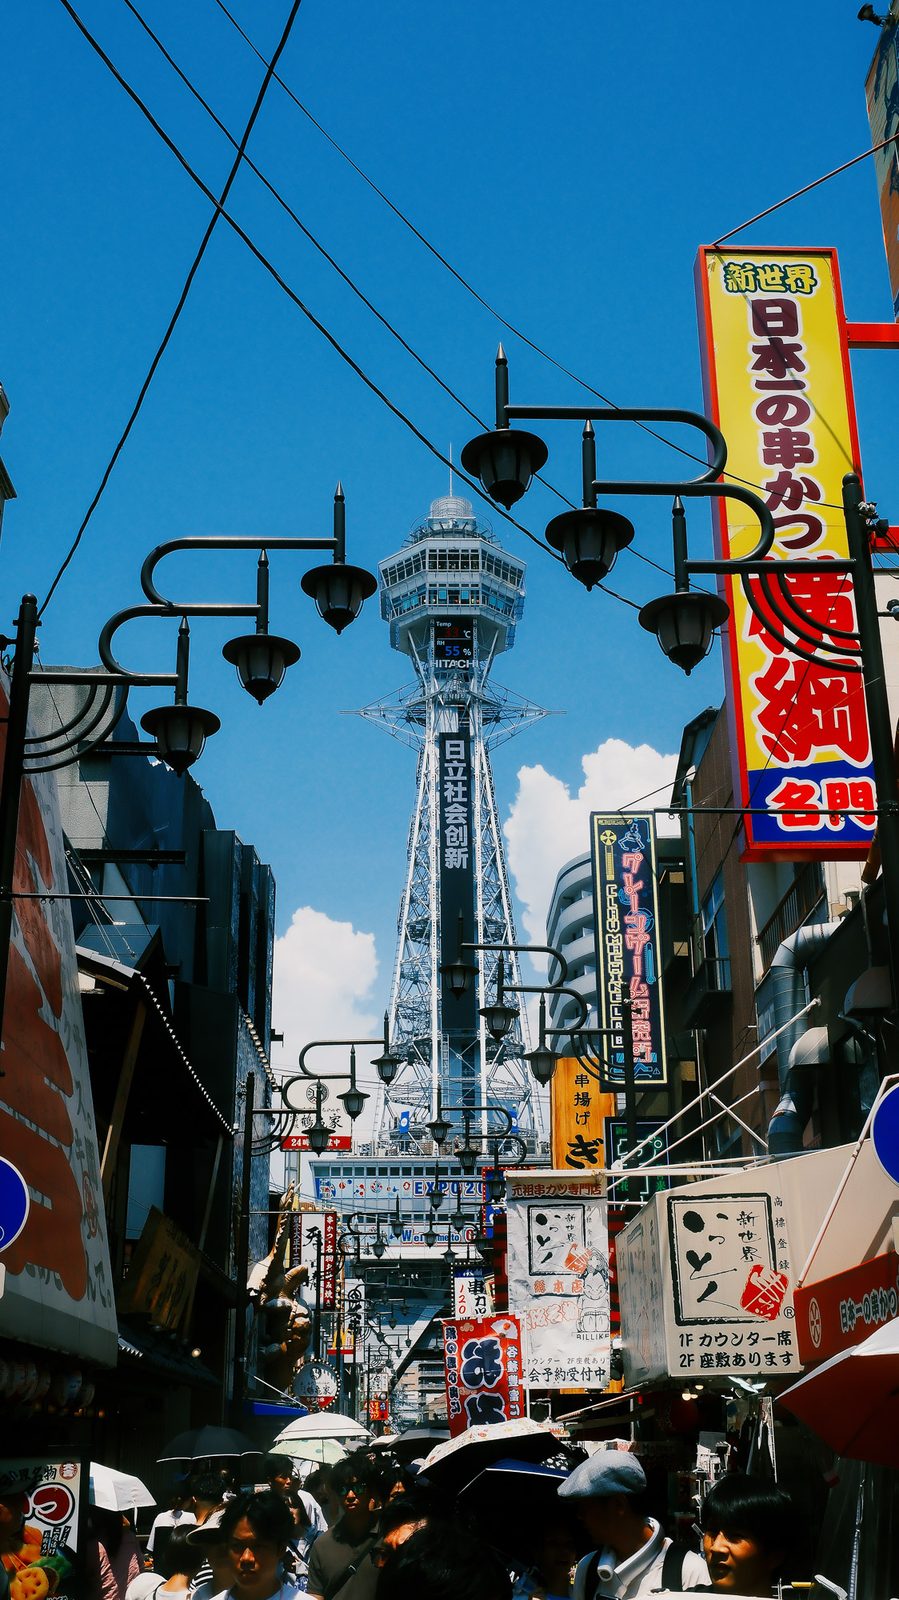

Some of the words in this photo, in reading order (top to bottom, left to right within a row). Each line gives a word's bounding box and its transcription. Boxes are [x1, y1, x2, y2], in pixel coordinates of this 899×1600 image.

[724, 263, 817, 296] 新世界
[751, 298, 822, 550] 日本一の串かつ
[430, 659, 478, 669] HITACHI
[444, 645, 460, 656] 55
[462, 648, 471, 656] %
[443, 738, 469, 870] 日立社会创新
[770, 780, 877, 827] 名門
[606, 884, 620, 932] CLAW
[573, 1073, 592, 1126] 串揚げ
[512, 1183, 603, 1197] 元祖串カツ専門店
[736, 1210, 763, 1264] 新世界
[679, 1333, 694, 1348] 1F
[699, 1330, 792, 1348] カウンター席
[522, 1366, 607, 1384] 会予約受付中
[680, 1353, 695, 1368] 2F
[700, 1350, 794, 1369] 座敷あります
